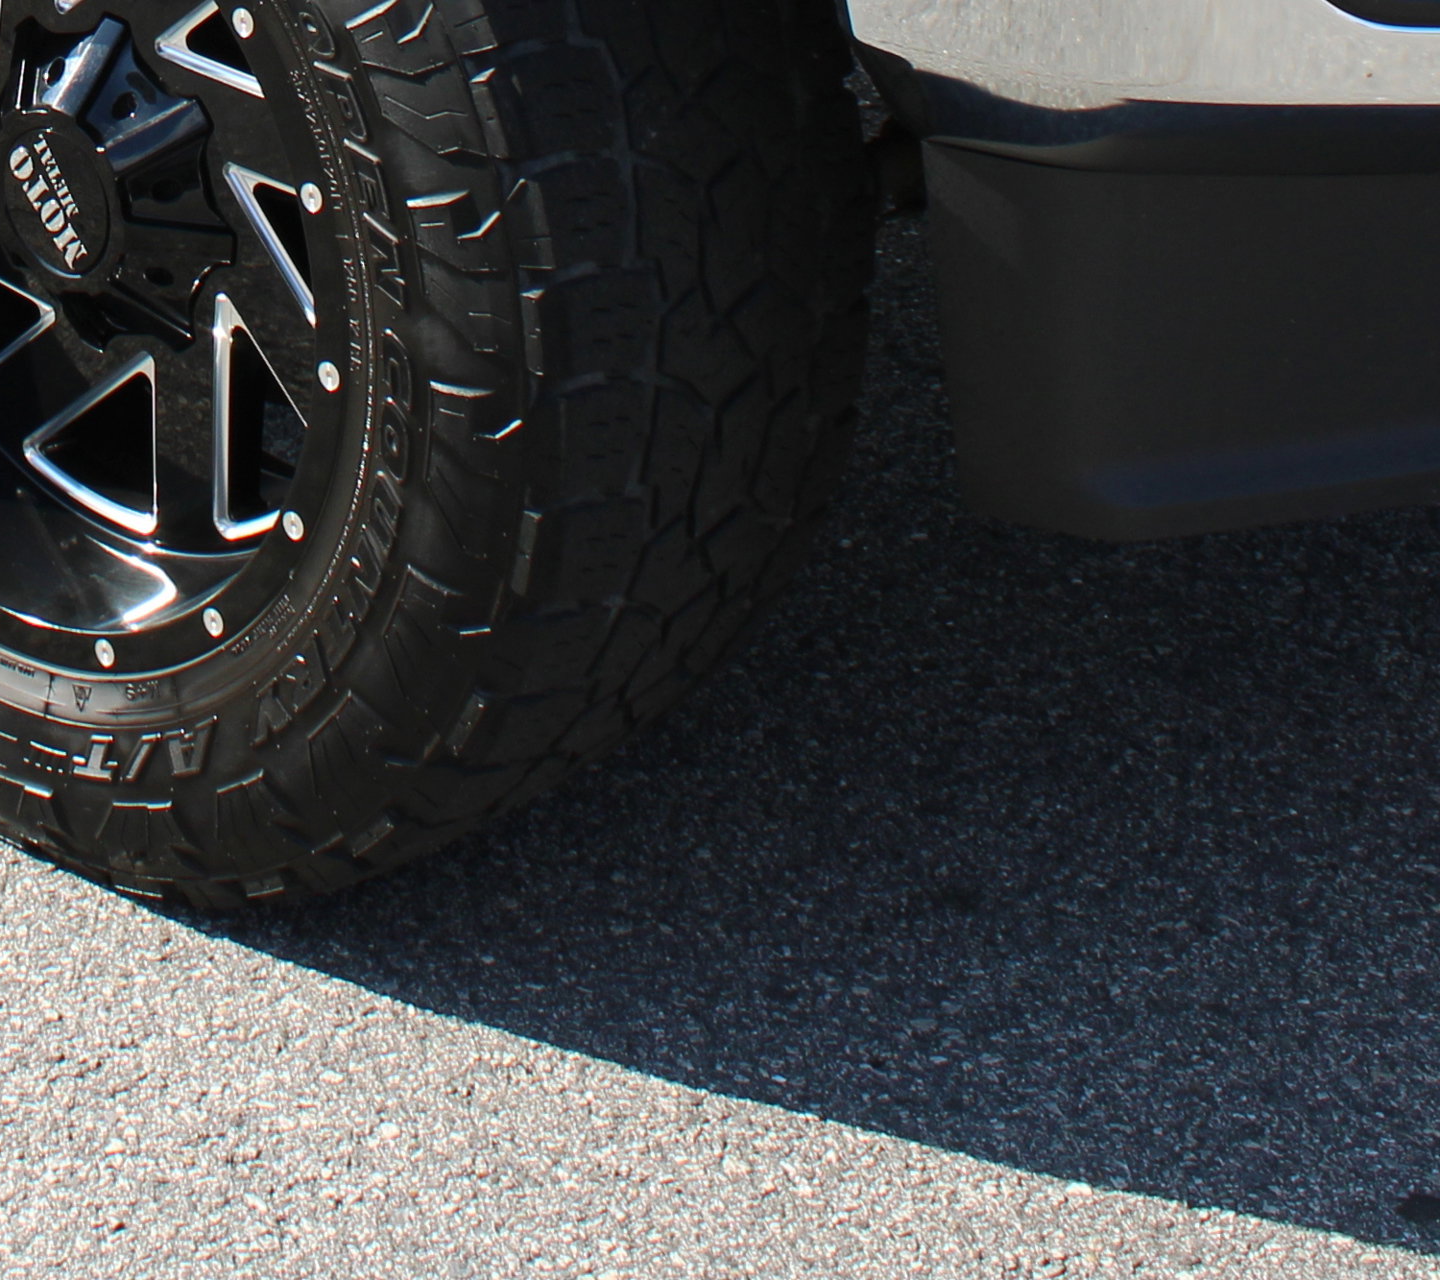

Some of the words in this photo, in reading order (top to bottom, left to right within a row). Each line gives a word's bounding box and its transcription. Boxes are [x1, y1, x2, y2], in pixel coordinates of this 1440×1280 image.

[9, 145, 88, 271] MOTO
[33, 133, 80, 218] METAL
[251, 326, 413, 747] COUNTRY
[72, 713, 218, 783] A/T
